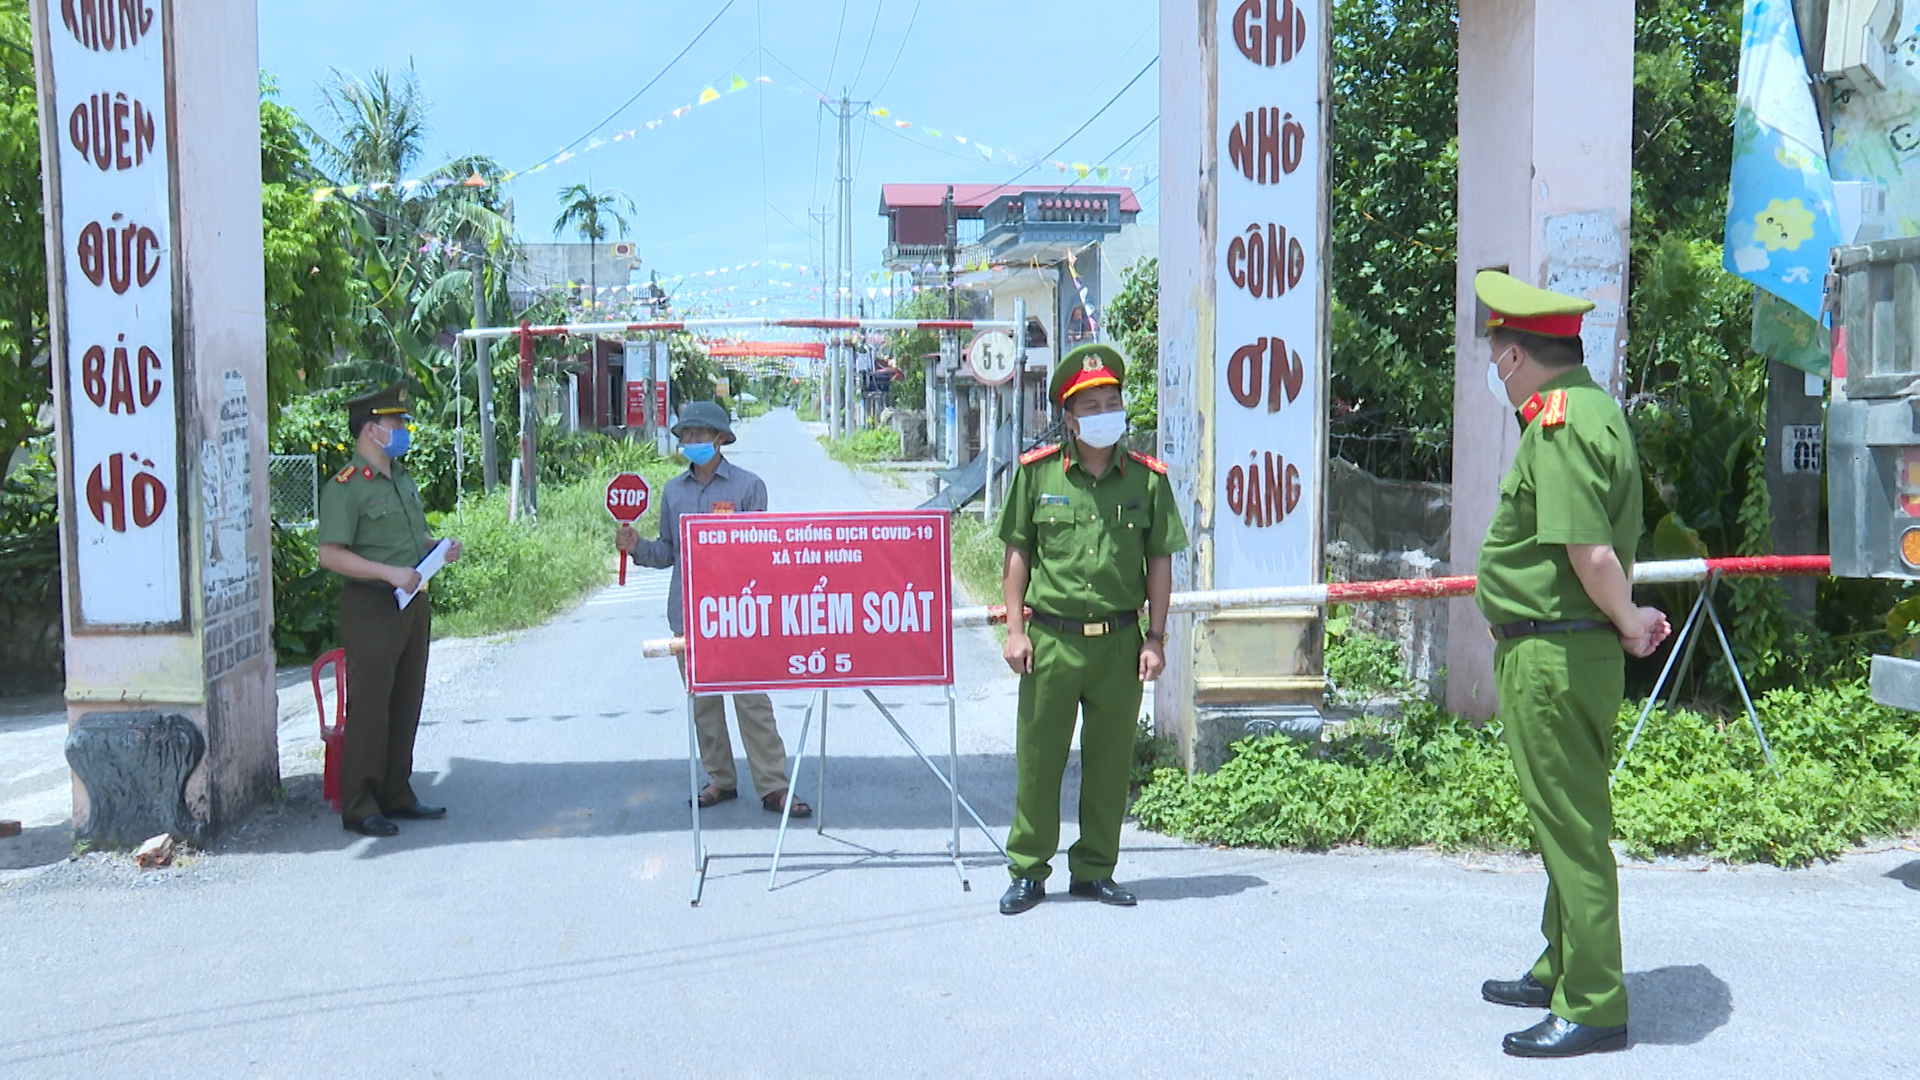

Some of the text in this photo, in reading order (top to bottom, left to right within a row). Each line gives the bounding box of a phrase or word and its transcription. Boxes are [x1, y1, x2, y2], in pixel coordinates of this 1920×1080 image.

[1233, 0, 1306, 67] GHI
[70, 92, 155, 171] QUÊN
[1229, 107, 1305, 185] NHỚ
[78, 212, 161, 295] ĐỨC
[1227, 223, 1305, 299] CÔNG
[82, 333, 162, 415] BÁC
[1227, 336, 1304, 414] ƠN
[86, 452, 167, 533] HỒ
[609, 488, 646, 506] STOP
[698, 523, 933, 544] BCĐ PHÒNG, CHỐNG DỊCH COVID-19
[794, 547, 821, 565] TÂN
[824, 548, 863, 564] HƯNG
[699, 575, 934, 639] CHỐT KIỂM SOÁT
[788, 647, 852, 675] SỐ 5
